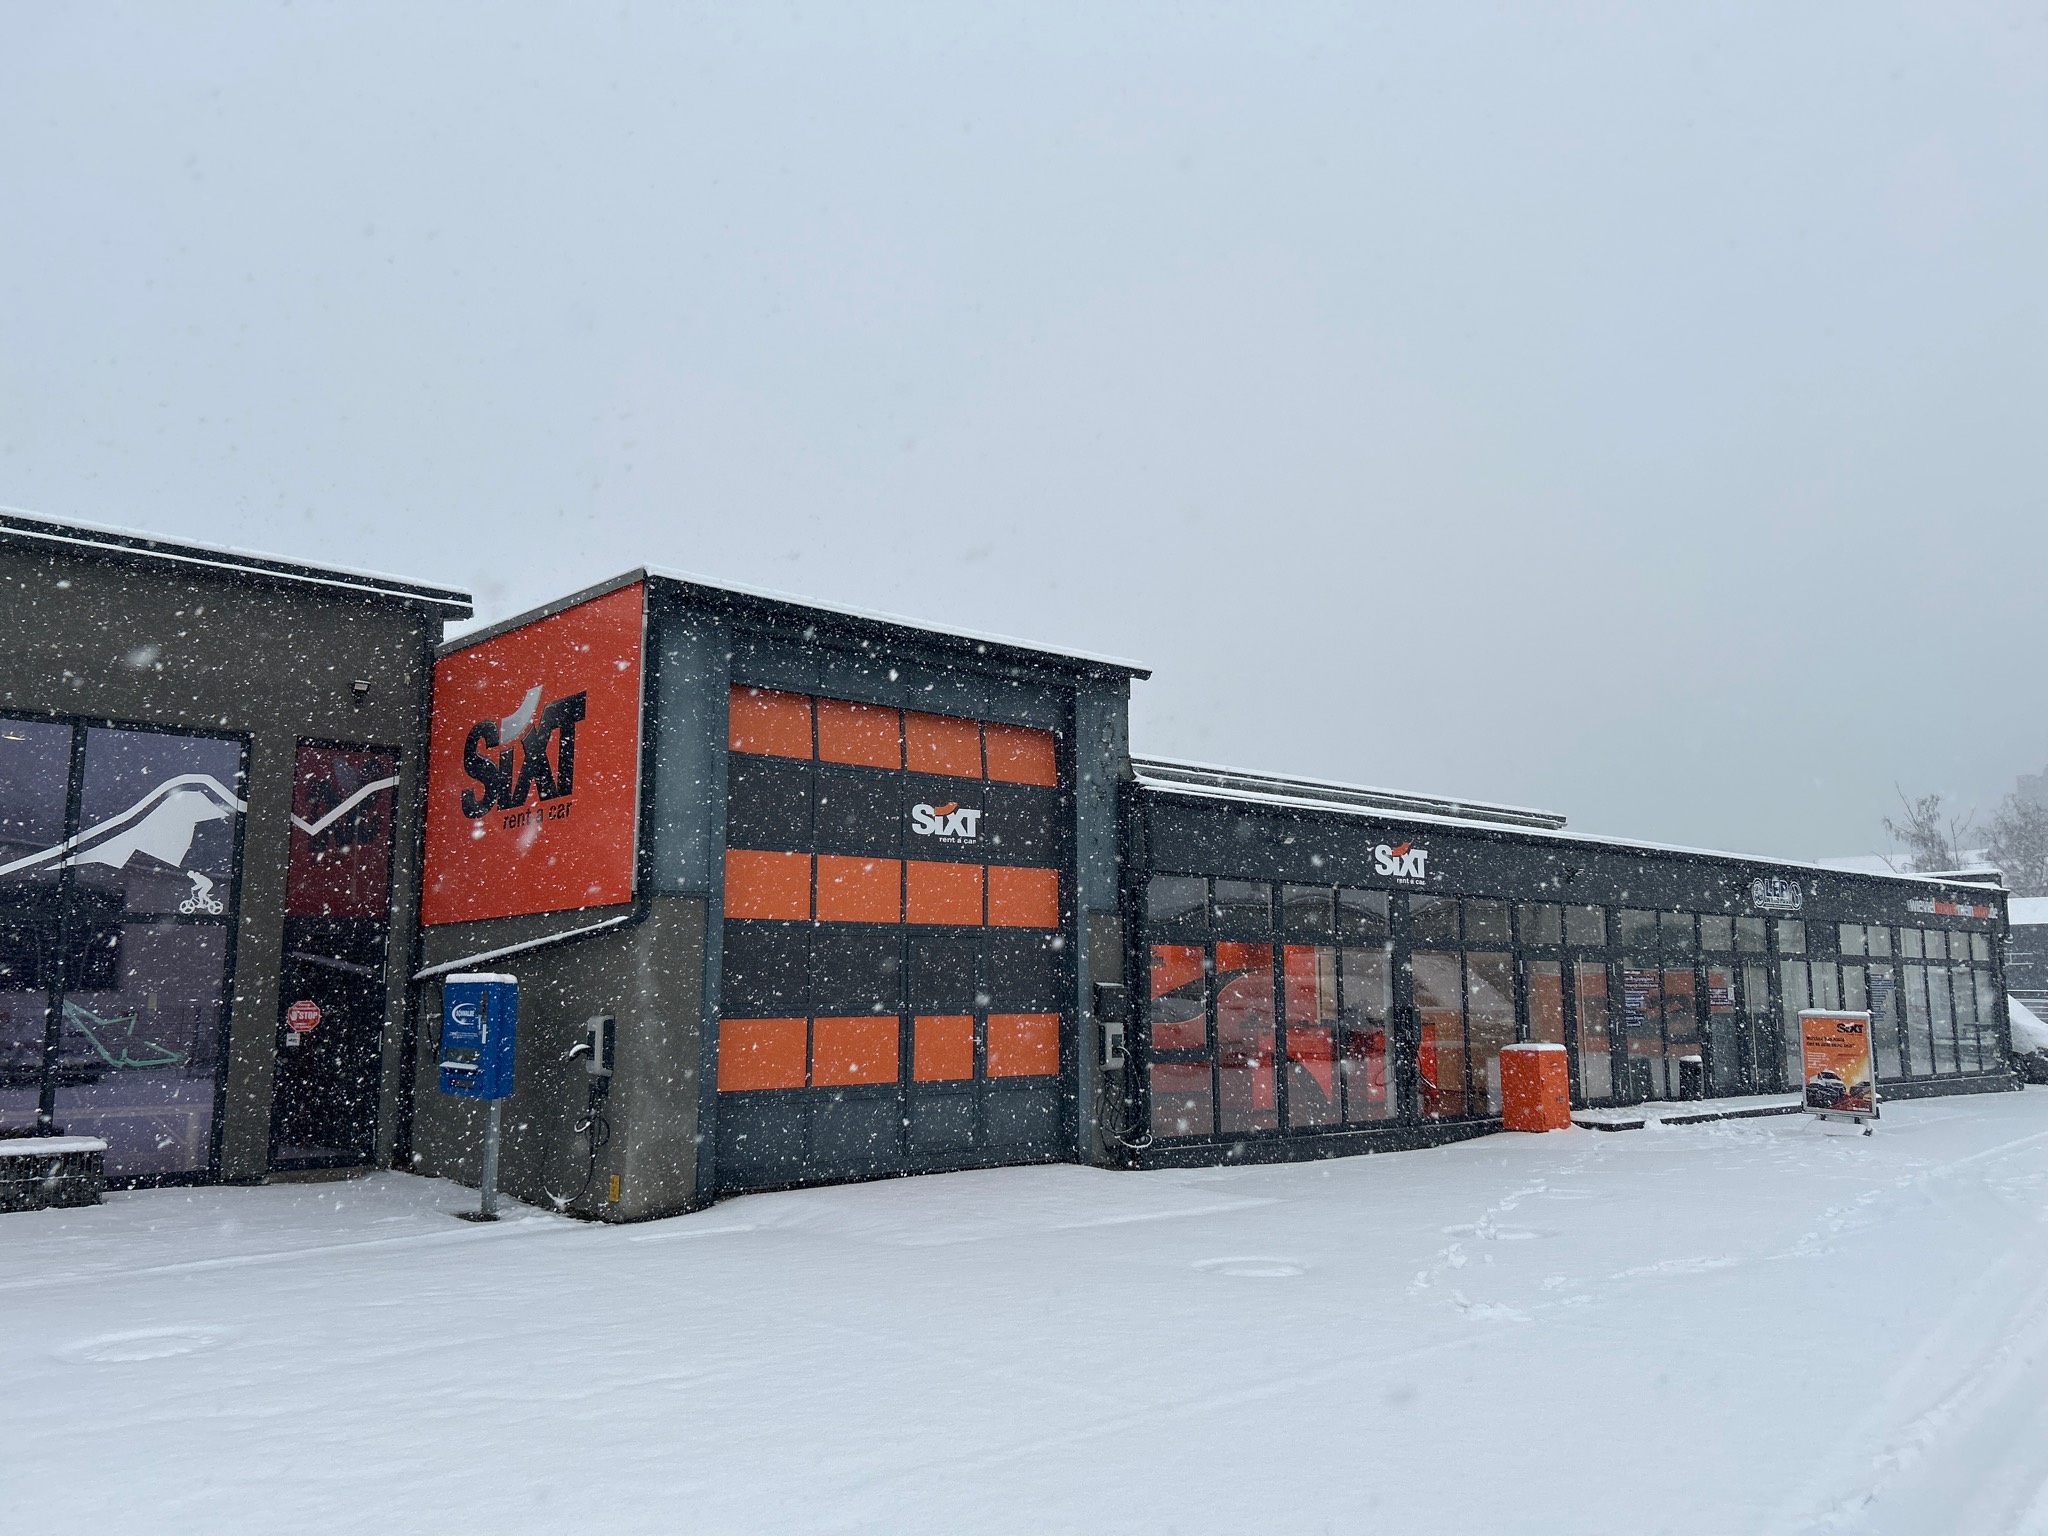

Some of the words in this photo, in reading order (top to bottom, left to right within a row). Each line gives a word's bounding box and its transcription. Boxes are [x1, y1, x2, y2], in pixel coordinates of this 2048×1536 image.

[462, 685, 587, 819] SIXT
[503, 808, 531, 830] rent
[535, 808, 544, 823] a
[550, 803, 572, 821] car
[911, 801, 981, 837] SIXT
[1374, 842, 1428, 878] SIXT
[298, 1011, 318, 1019] STOP
